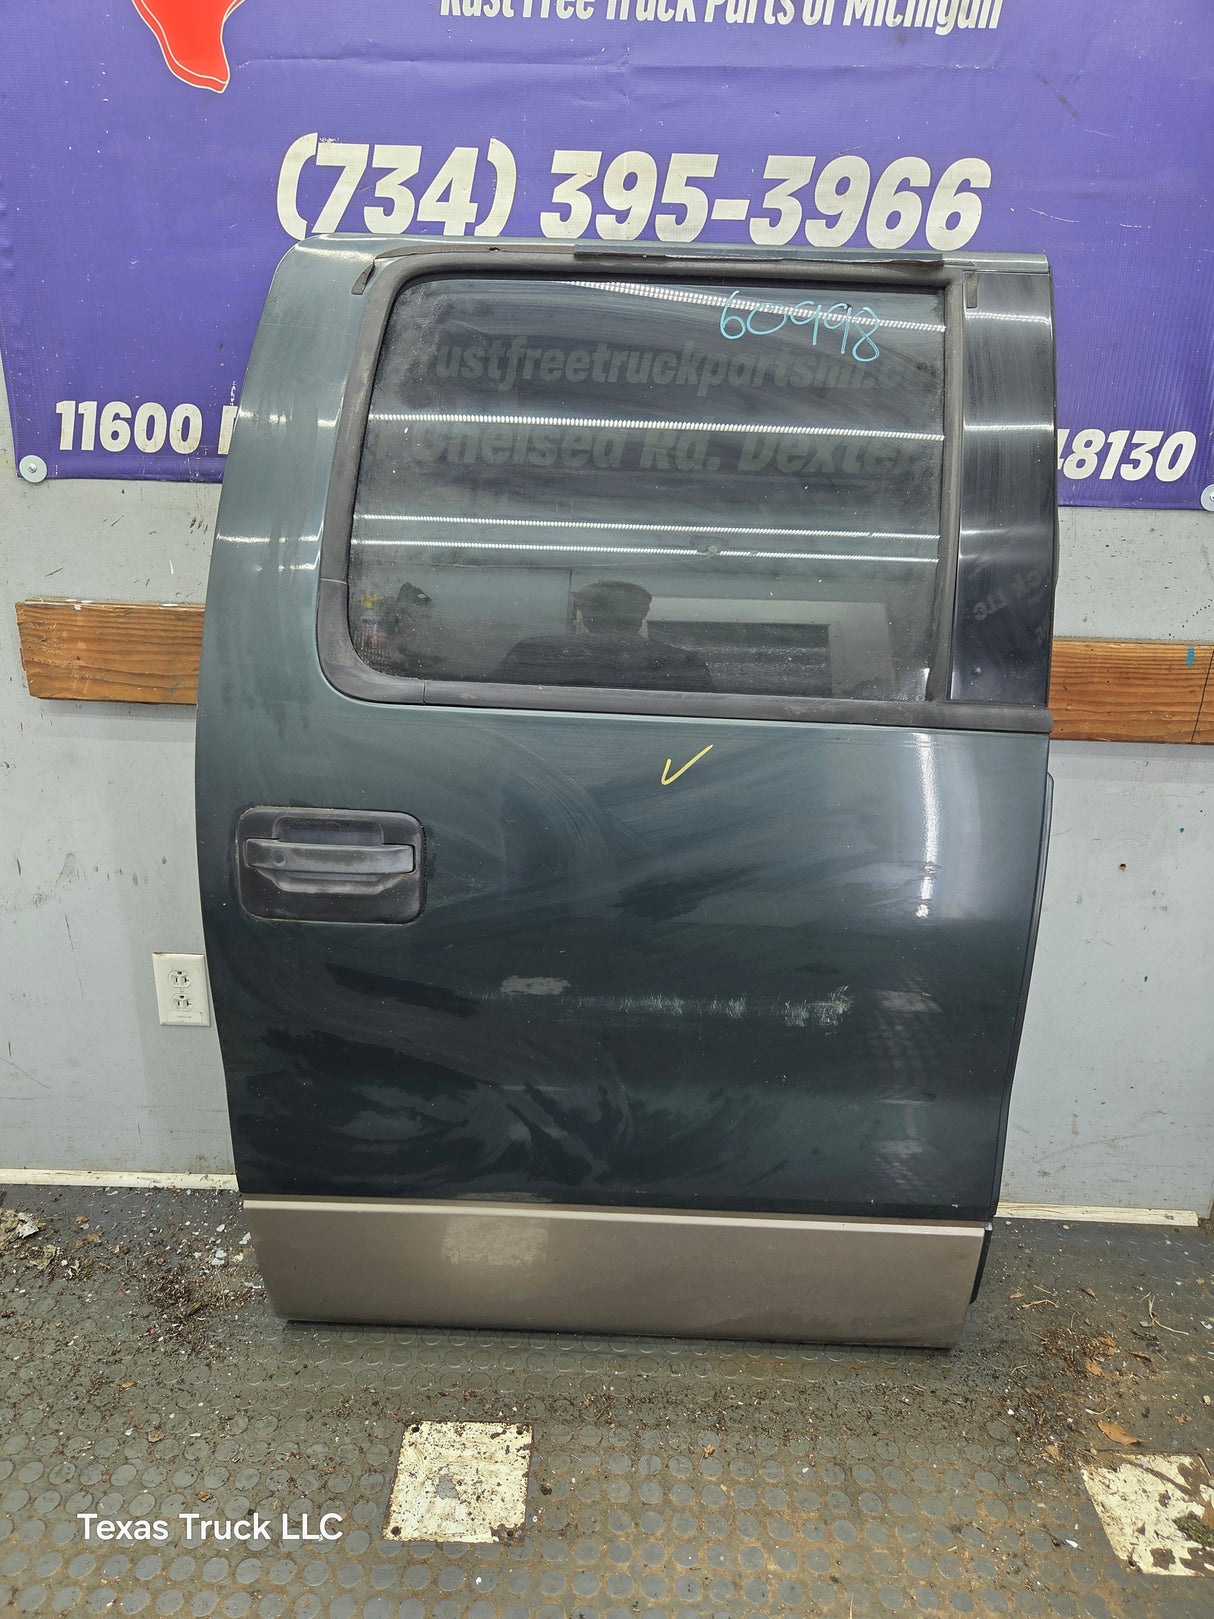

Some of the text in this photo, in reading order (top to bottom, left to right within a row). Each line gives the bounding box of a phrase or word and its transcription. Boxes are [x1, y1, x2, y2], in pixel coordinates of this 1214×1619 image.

[843, 0, 1004, 36] Michigan
[277, 132, 992, 251] (734) 395-3966
[720, 290, 880, 362] 60998
[55, 400, 203, 454] 11600
